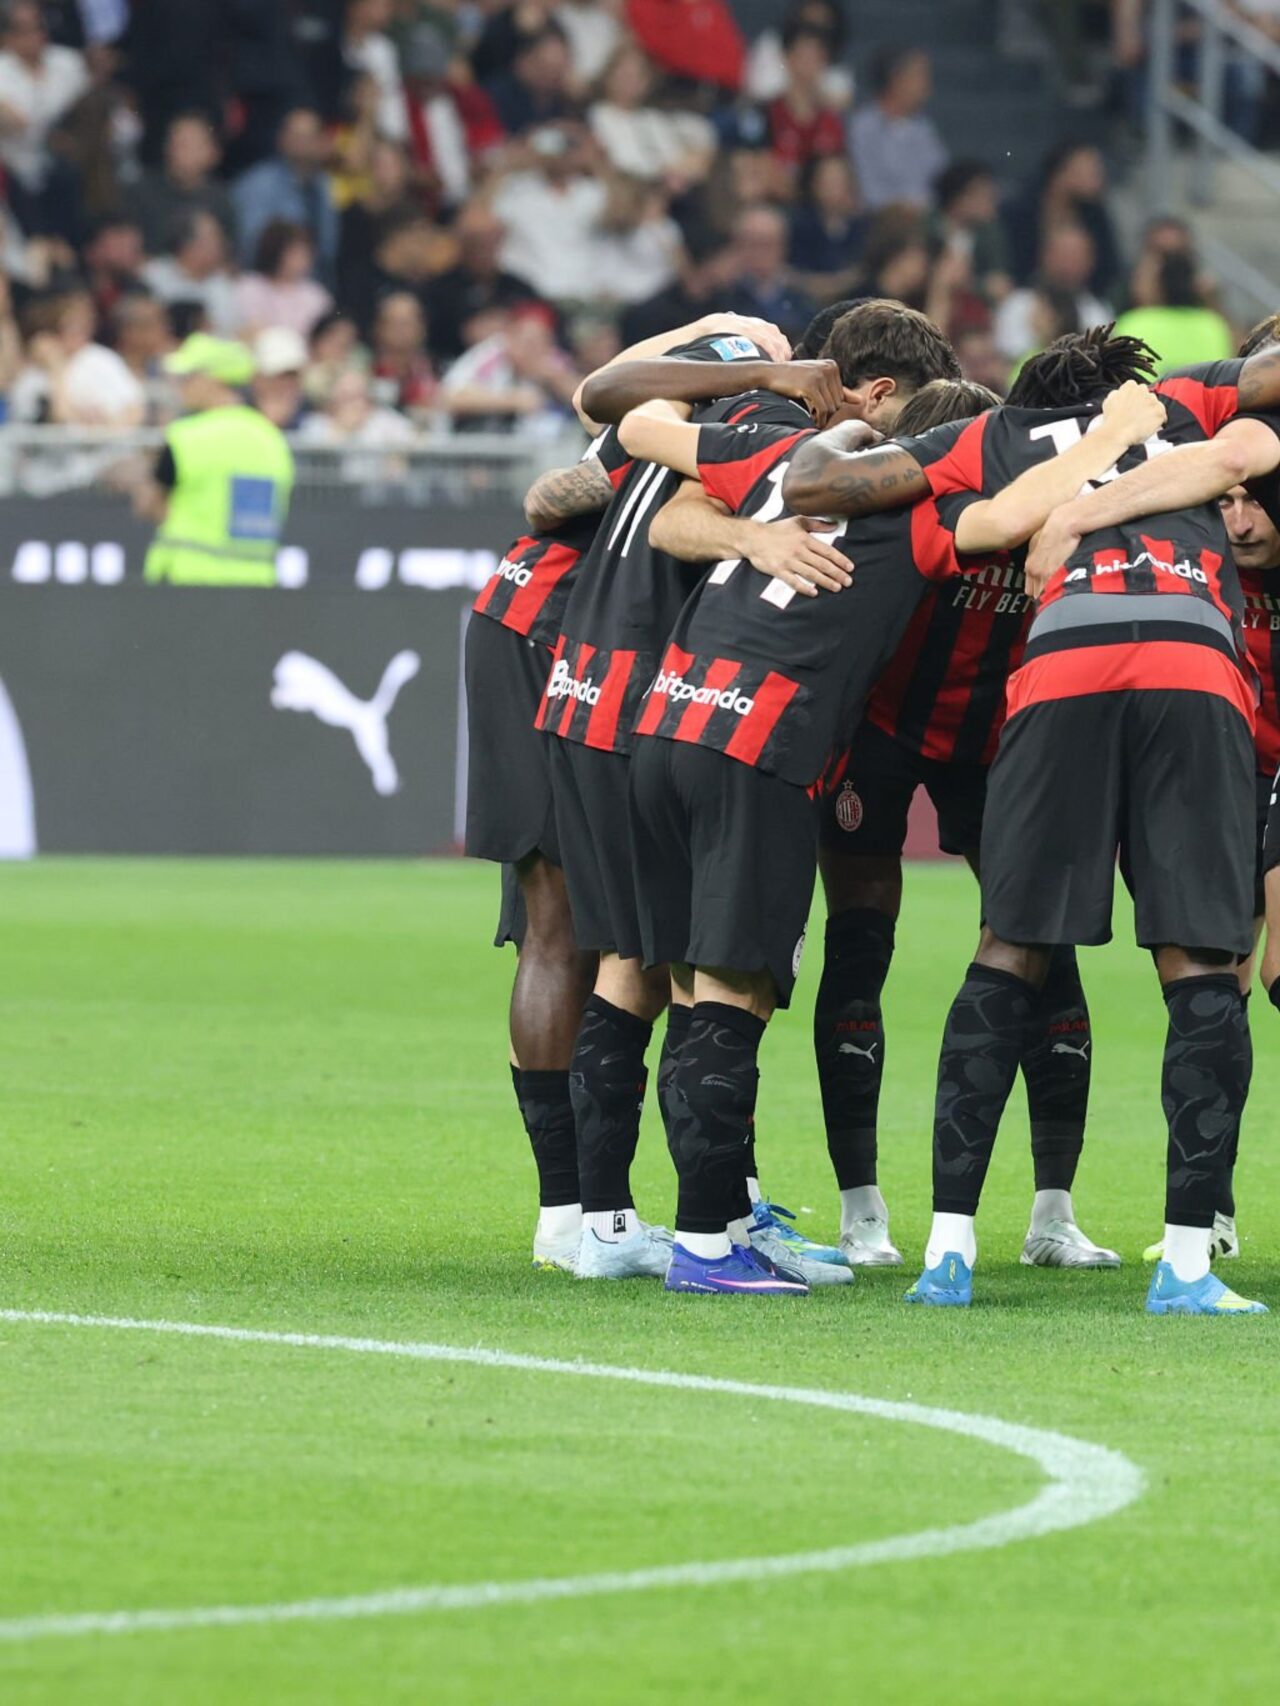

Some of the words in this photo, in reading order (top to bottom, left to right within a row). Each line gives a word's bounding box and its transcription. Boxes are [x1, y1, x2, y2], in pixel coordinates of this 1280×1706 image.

[607, 461, 670, 557] 11
[951, 585, 993, 611] FLY
[994, 592, 1034, 614] BET
[653, 668, 755, 716] bitpanda
